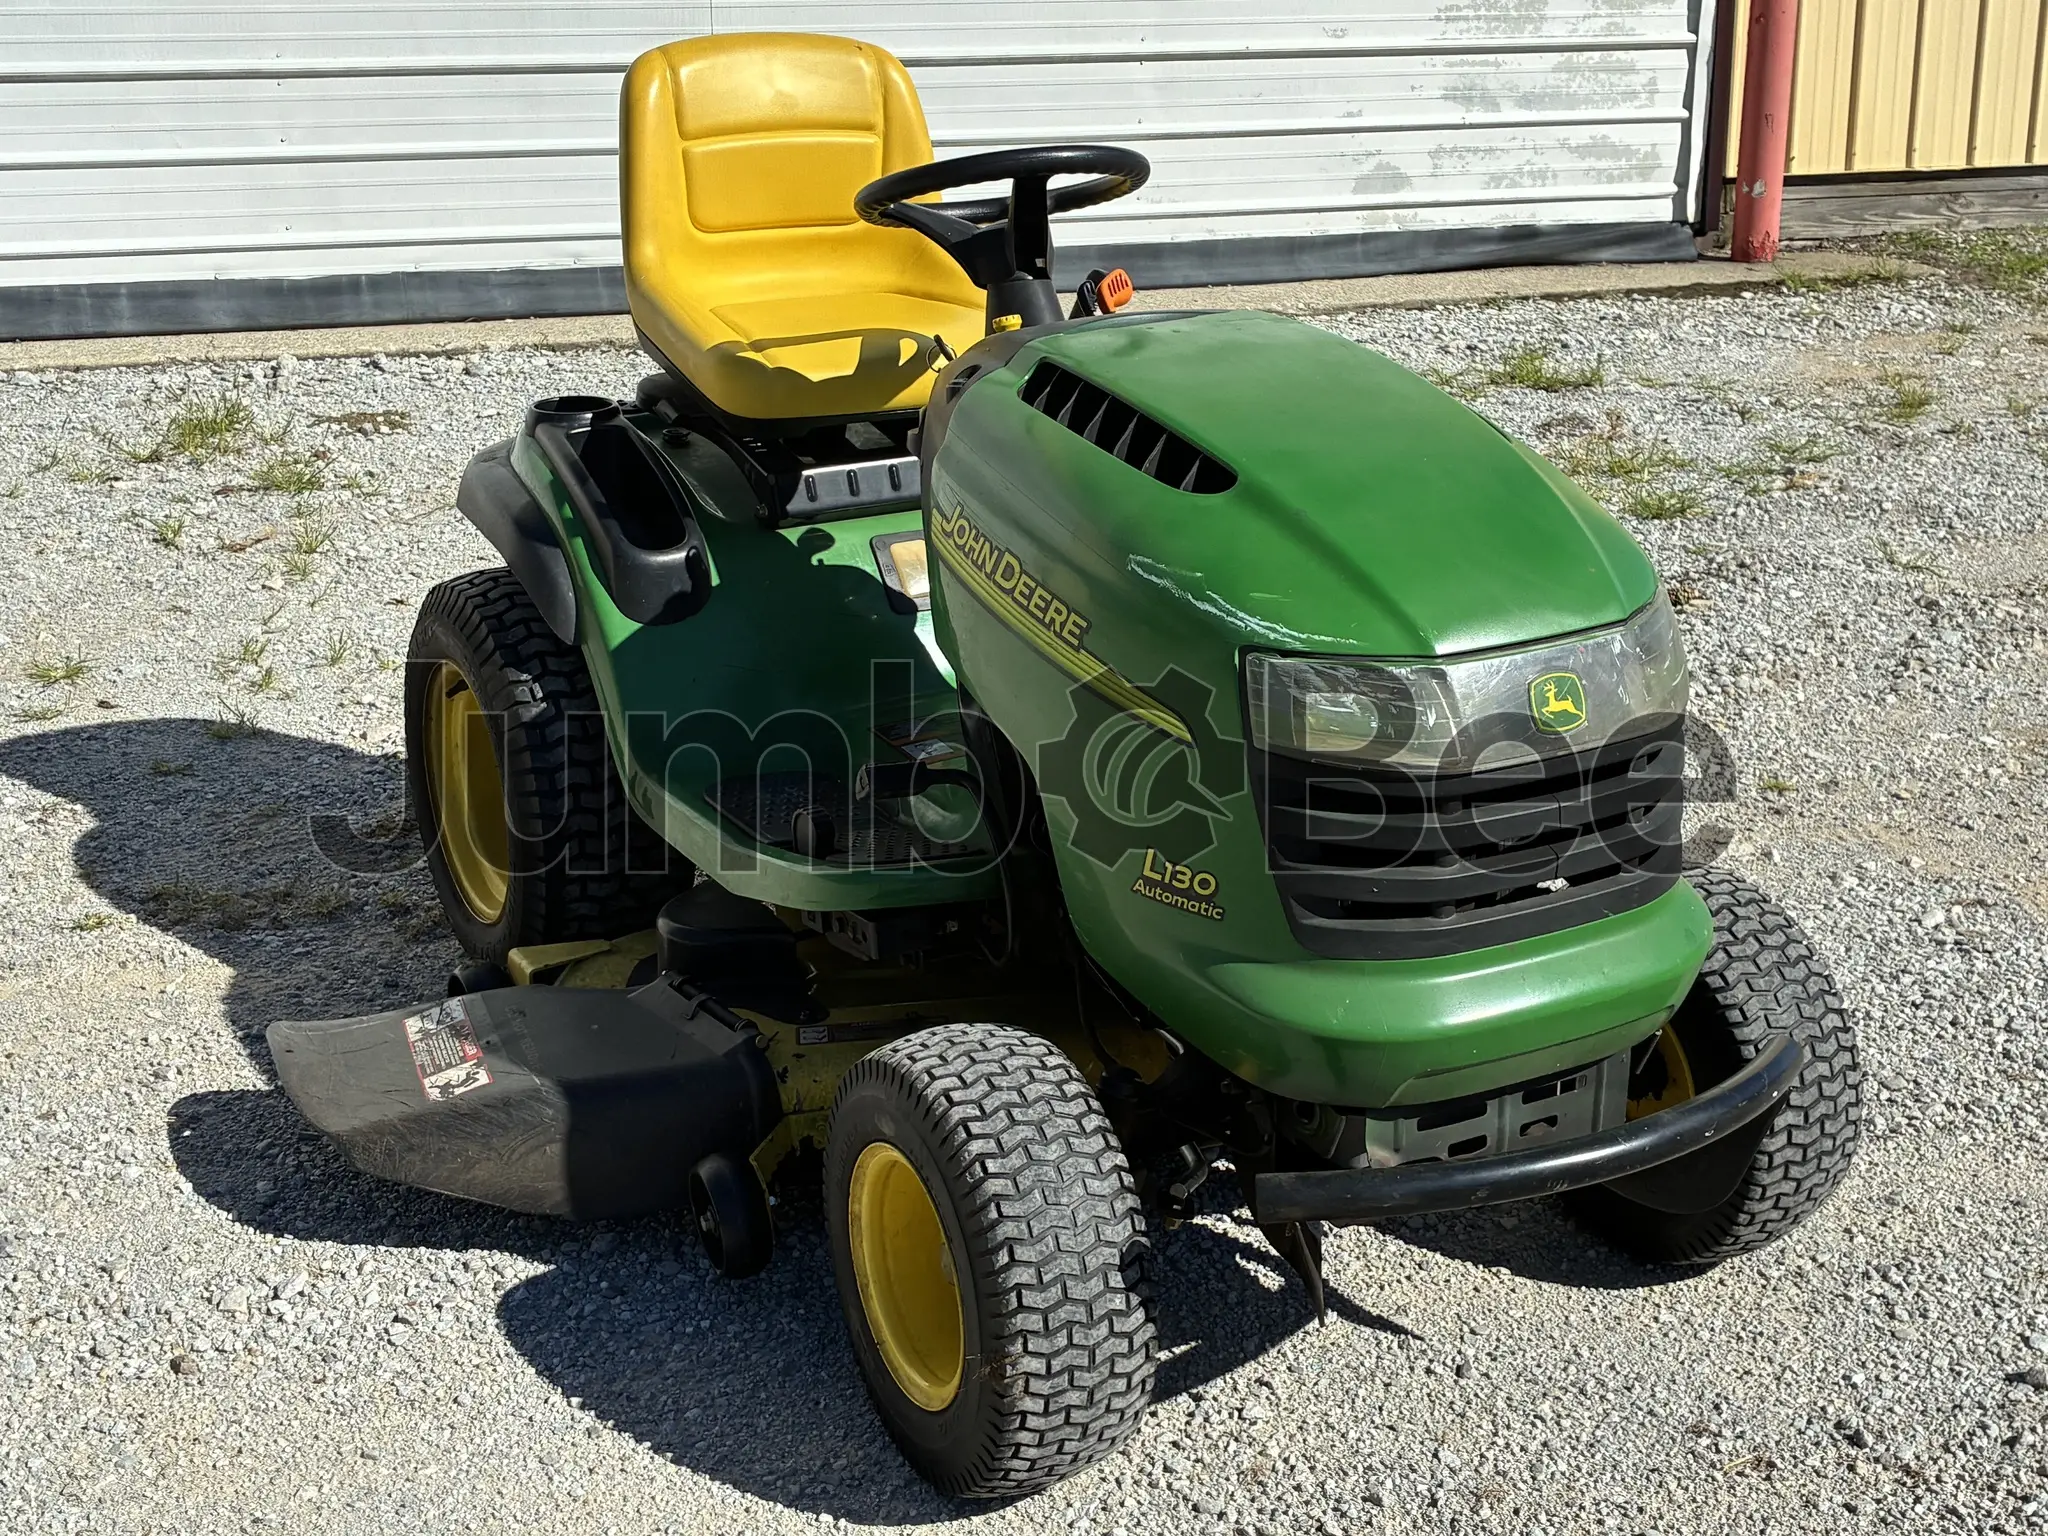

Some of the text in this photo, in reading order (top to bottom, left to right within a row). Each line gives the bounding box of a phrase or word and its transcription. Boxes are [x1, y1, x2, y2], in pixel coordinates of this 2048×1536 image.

[941, 505, 1088, 647] JOHN DEERE
[1142, 848, 1217, 896] L130
[1132, 878, 1224, 919] Automatic
